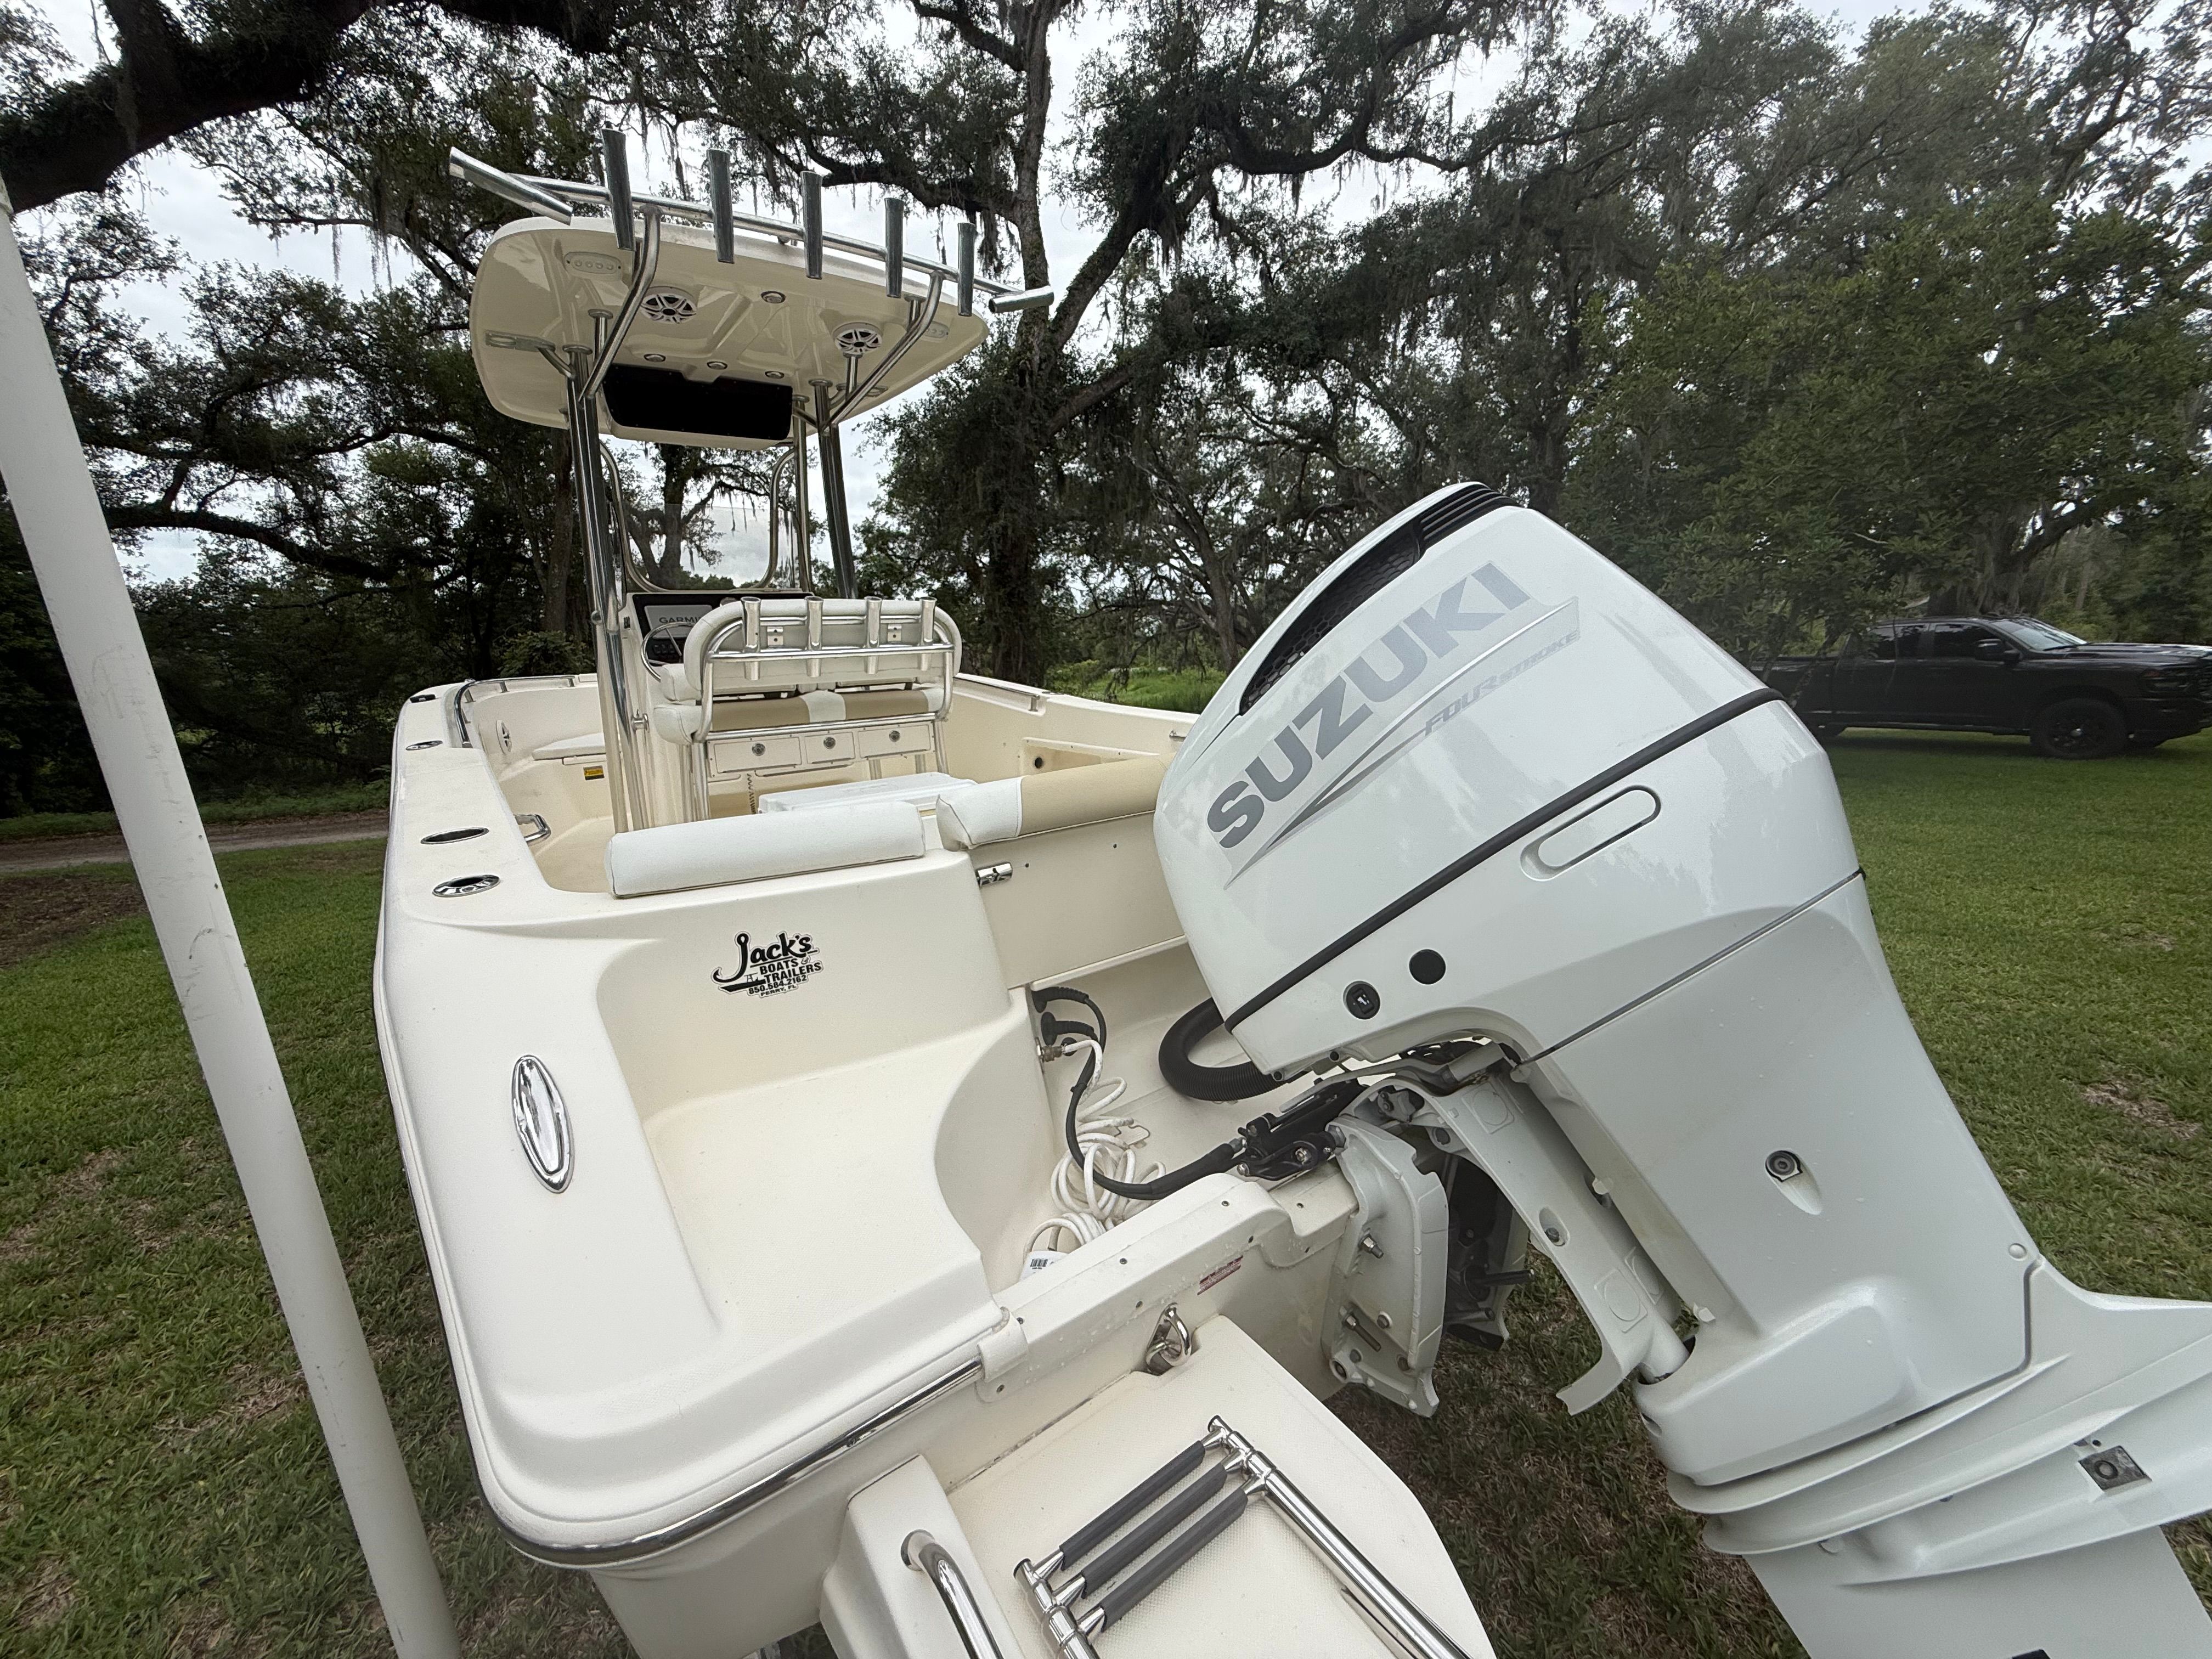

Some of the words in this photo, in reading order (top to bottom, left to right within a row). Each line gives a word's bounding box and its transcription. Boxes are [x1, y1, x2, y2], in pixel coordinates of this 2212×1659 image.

[1206, 562, 1531, 849] SUZUKI
[713, 933, 812, 983] Jack's
[759, 958, 799, 975] BOATS
[800, 957, 809, 965] &
[764, 962, 822, 984] TRAILERS
[748, 975, 808, 995] 850.584.2162
